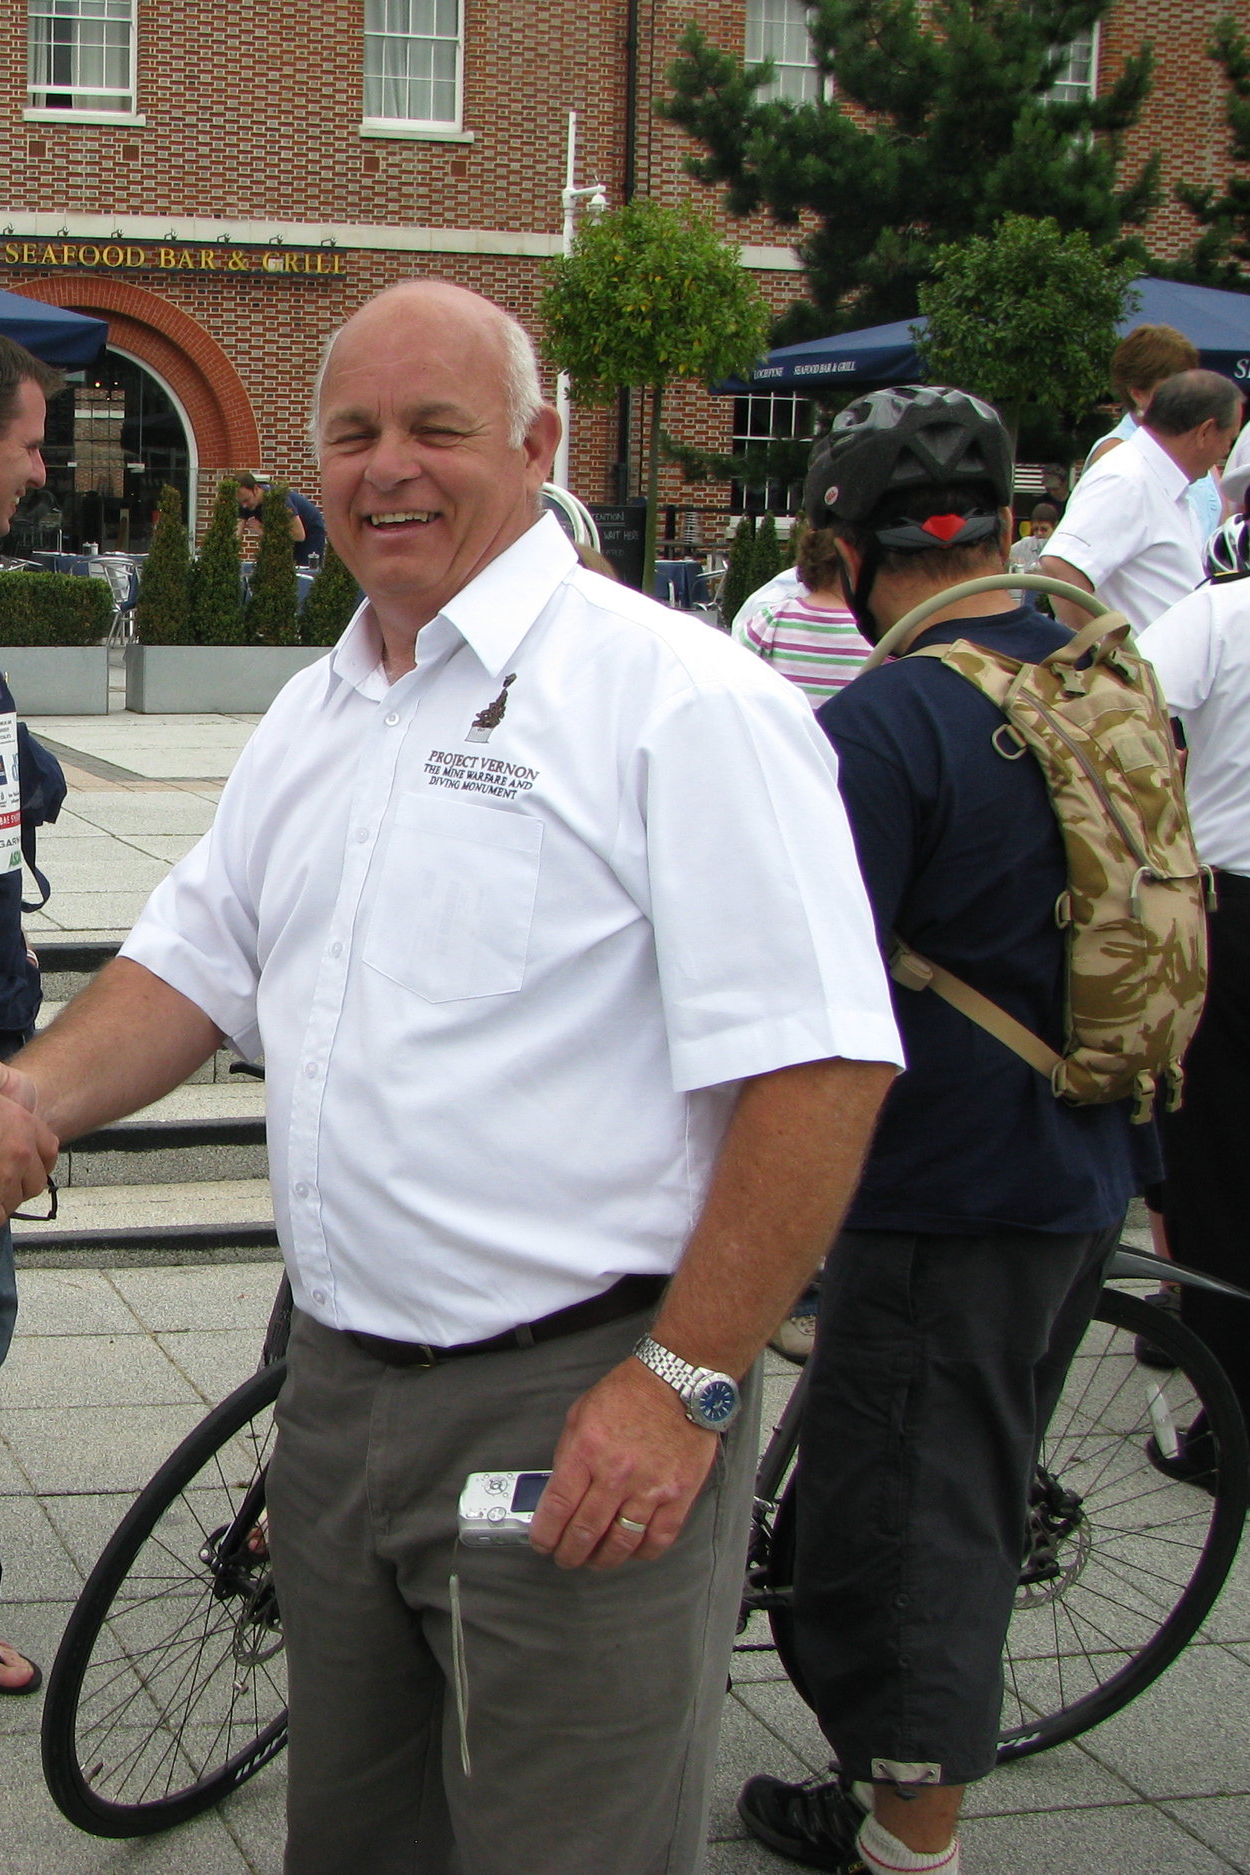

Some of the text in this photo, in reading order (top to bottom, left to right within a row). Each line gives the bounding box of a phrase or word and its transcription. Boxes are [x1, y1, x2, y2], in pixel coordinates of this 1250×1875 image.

[5, 242, 146, 269] SEAFOOD
[159, 248, 216, 271] BAR
[228, 250, 250, 272] &
[262, 251, 347, 275] GRILL
[793, 365, 819, 375] SEAFOOD
[819, 362, 832, 374] BAR
[837, 361, 856, 372] GRILL
[423, 763, 534, 791] THE MINE WARFARE AND
[427, 750, 540, 781] PROJECT VERNON
[429, 776, 518, 800] DIVING MONUMENT
[0, 814, 10, 826] BAE
